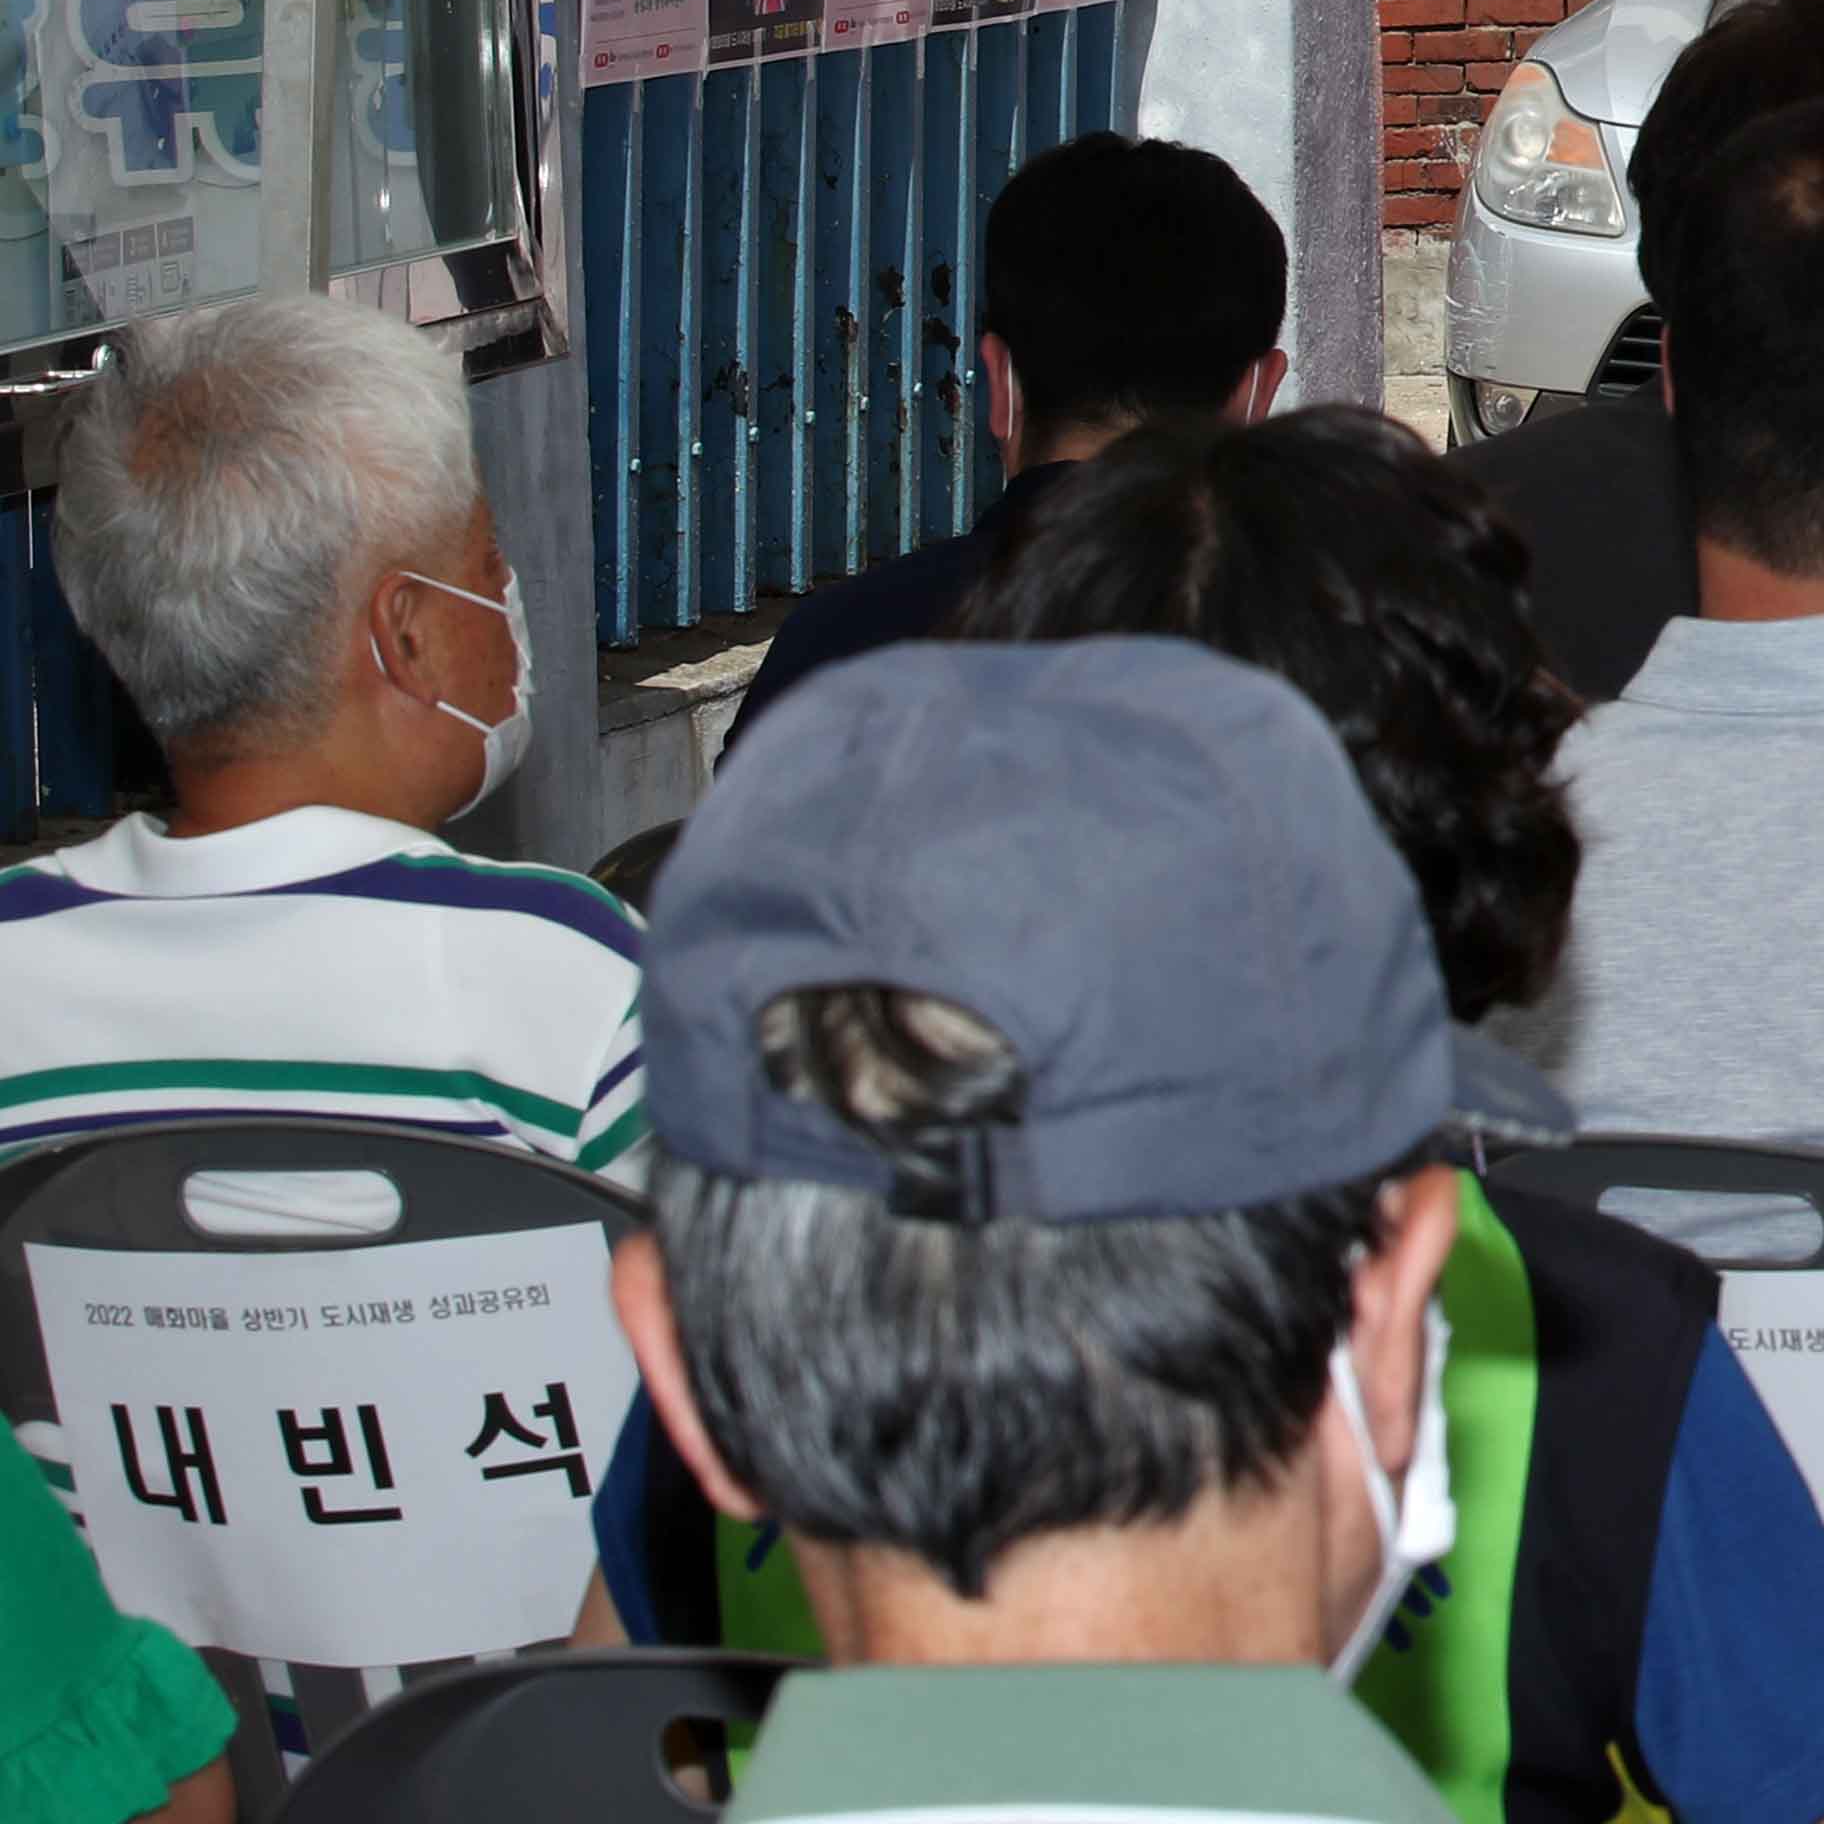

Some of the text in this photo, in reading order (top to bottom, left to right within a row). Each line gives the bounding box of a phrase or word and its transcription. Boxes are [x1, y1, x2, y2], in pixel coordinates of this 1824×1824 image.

[85, 1283, 551, 1332] 2022 매화마을 상반기 도시재생 성과공유회
